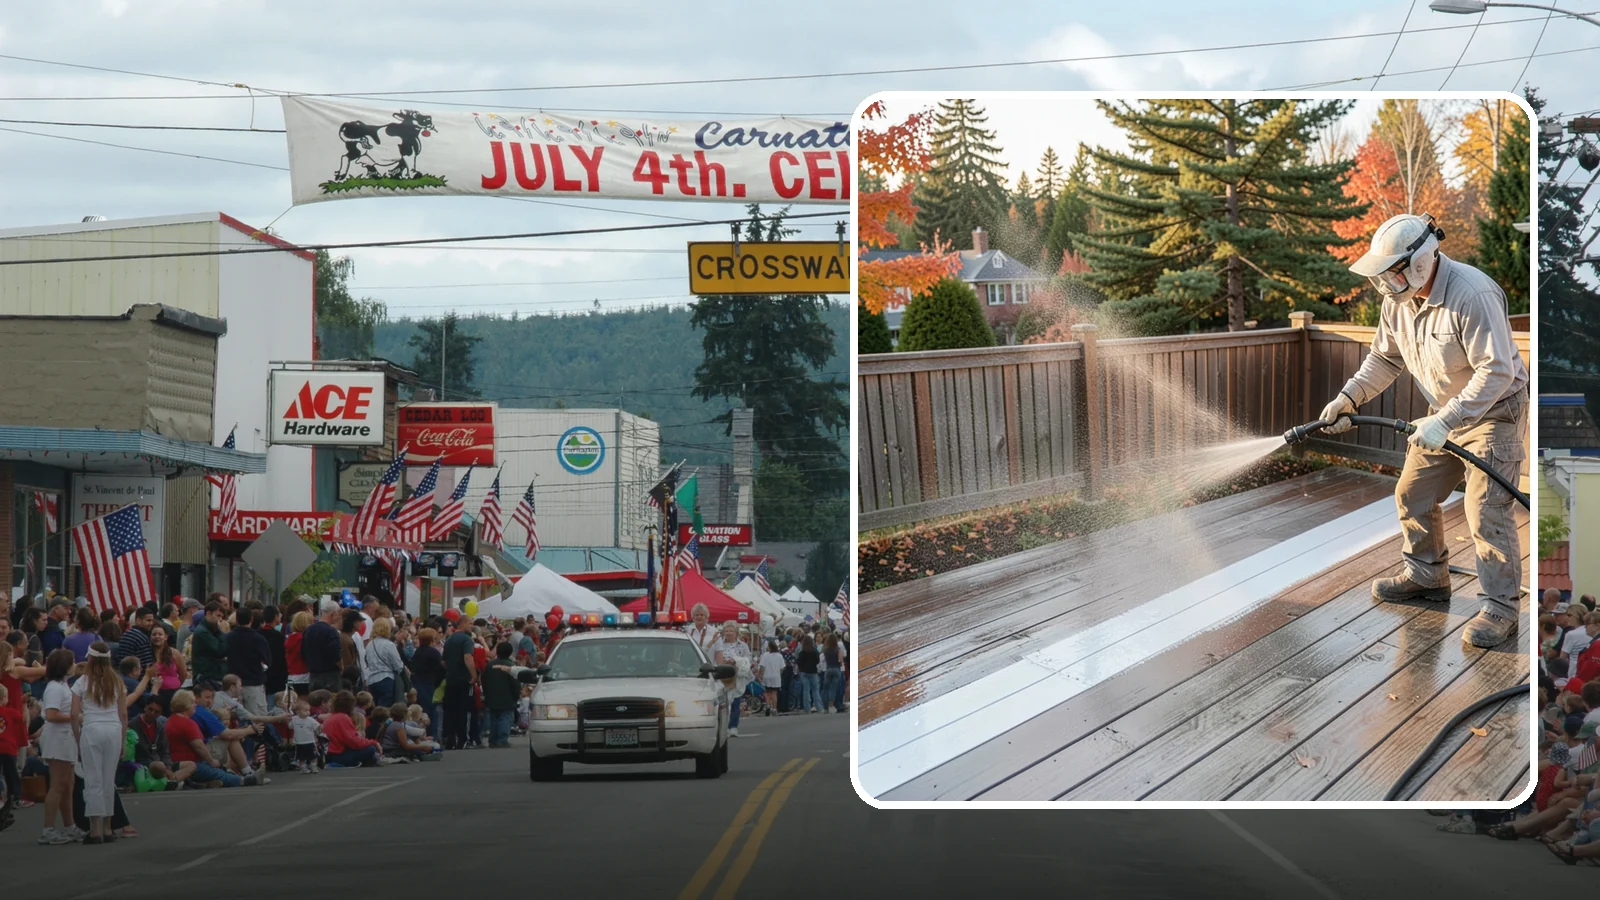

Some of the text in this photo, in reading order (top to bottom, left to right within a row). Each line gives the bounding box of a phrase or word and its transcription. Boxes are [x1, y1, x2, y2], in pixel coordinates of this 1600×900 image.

[481, 141, 605, 192] JULY
[632, 150, 746, 198] 4th.
[697, 254, 850, 280] CROSSWA
[282, 380, 373, 420] ACE
[406, 409, 452, 422] CEDAR
[283, 421, 371, 436] Hardware
[416, 428, 477, 446] Coca-Cola
[353, 467, 387, 481] Simpl
[95, 485, 124, 494] Vincent
[126, 486, 135, 495] de
[137, 486, 155, 495] Paul
[688, 526, 741, 535] CRNATION
[698, 535, 730, 543] GLASS
